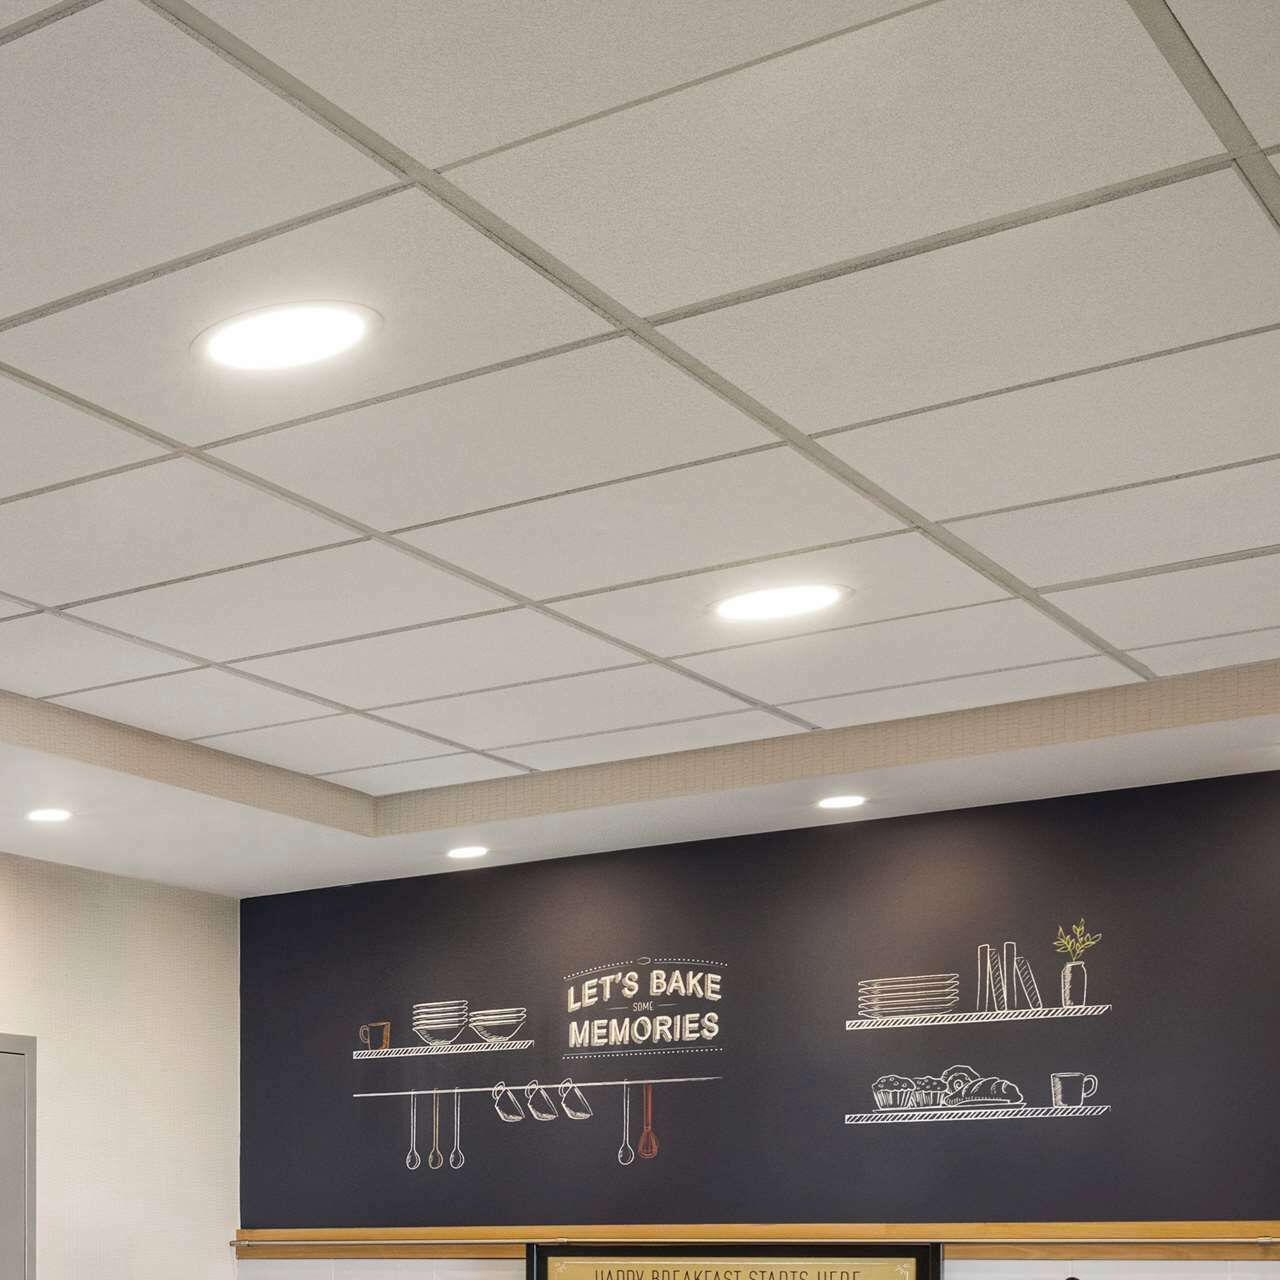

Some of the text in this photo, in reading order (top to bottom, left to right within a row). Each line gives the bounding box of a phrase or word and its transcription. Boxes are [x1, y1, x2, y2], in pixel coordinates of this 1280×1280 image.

[567, 970, 722, 1013] LET'S BAKE
[632, 1001, 654, 1012] SOME
[568, 1012, 720, 1048] MEMORIES
